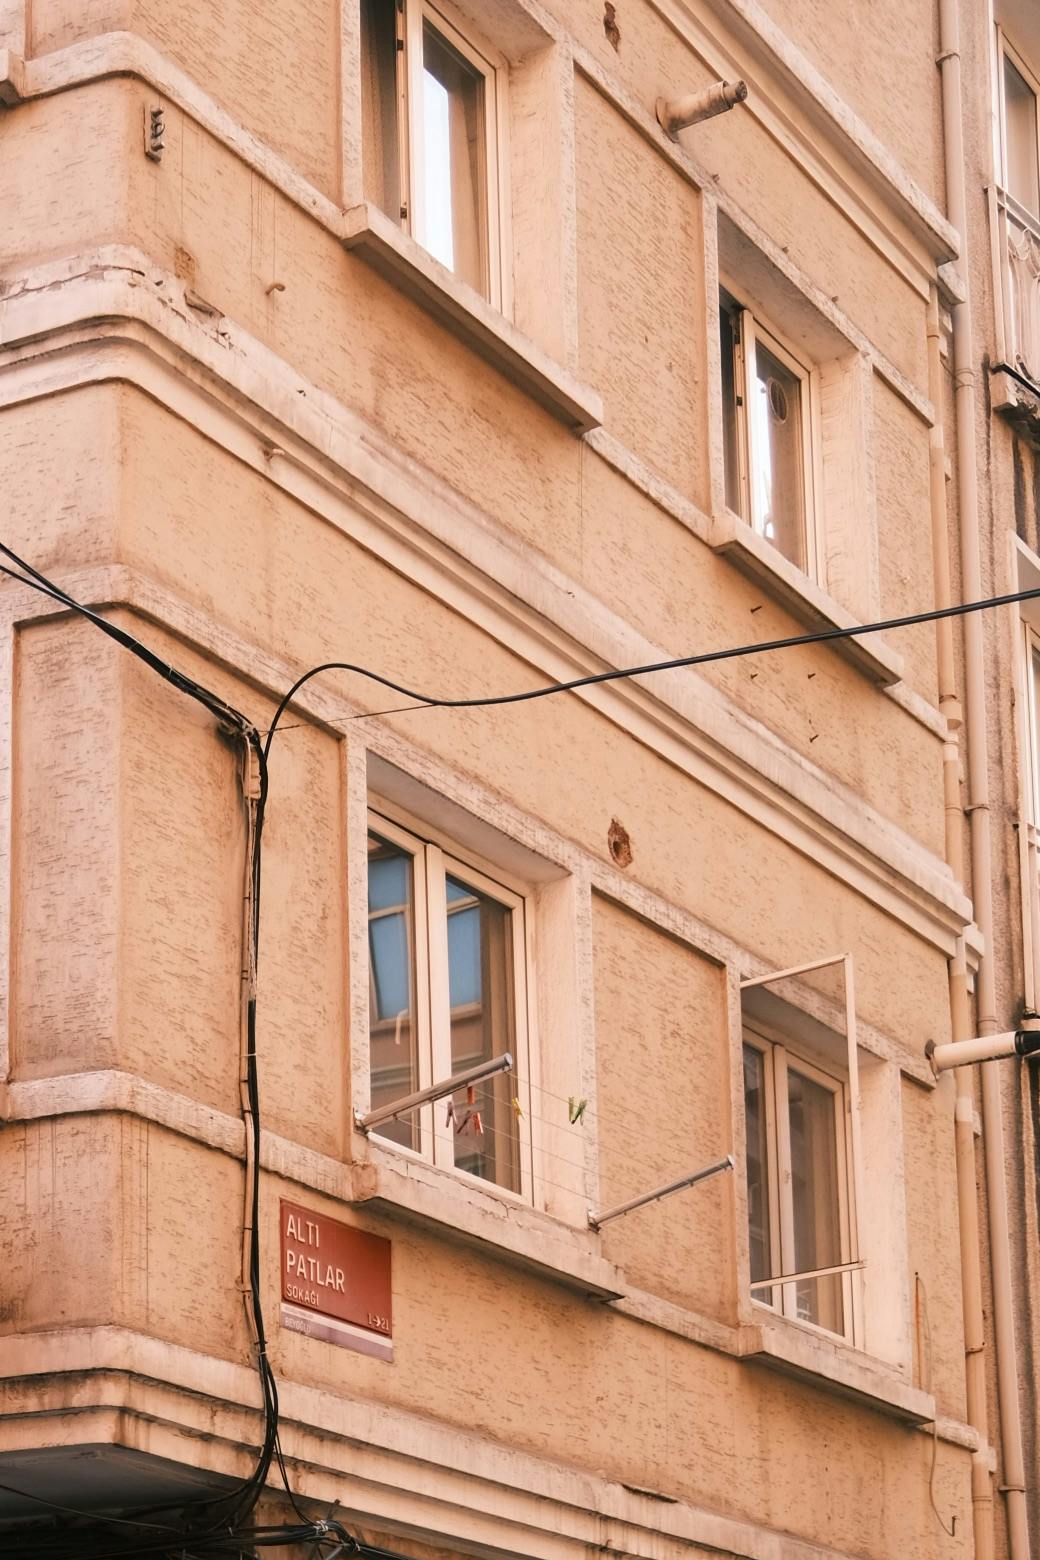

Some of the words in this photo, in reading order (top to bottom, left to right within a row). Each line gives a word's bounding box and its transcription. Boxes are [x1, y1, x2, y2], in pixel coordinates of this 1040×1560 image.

[286, 1214, 320, 1248] ALTI
[286, 1250, 346, 1292] PATLAR
[286, 1284, 320, 1306] SOKAĞI
